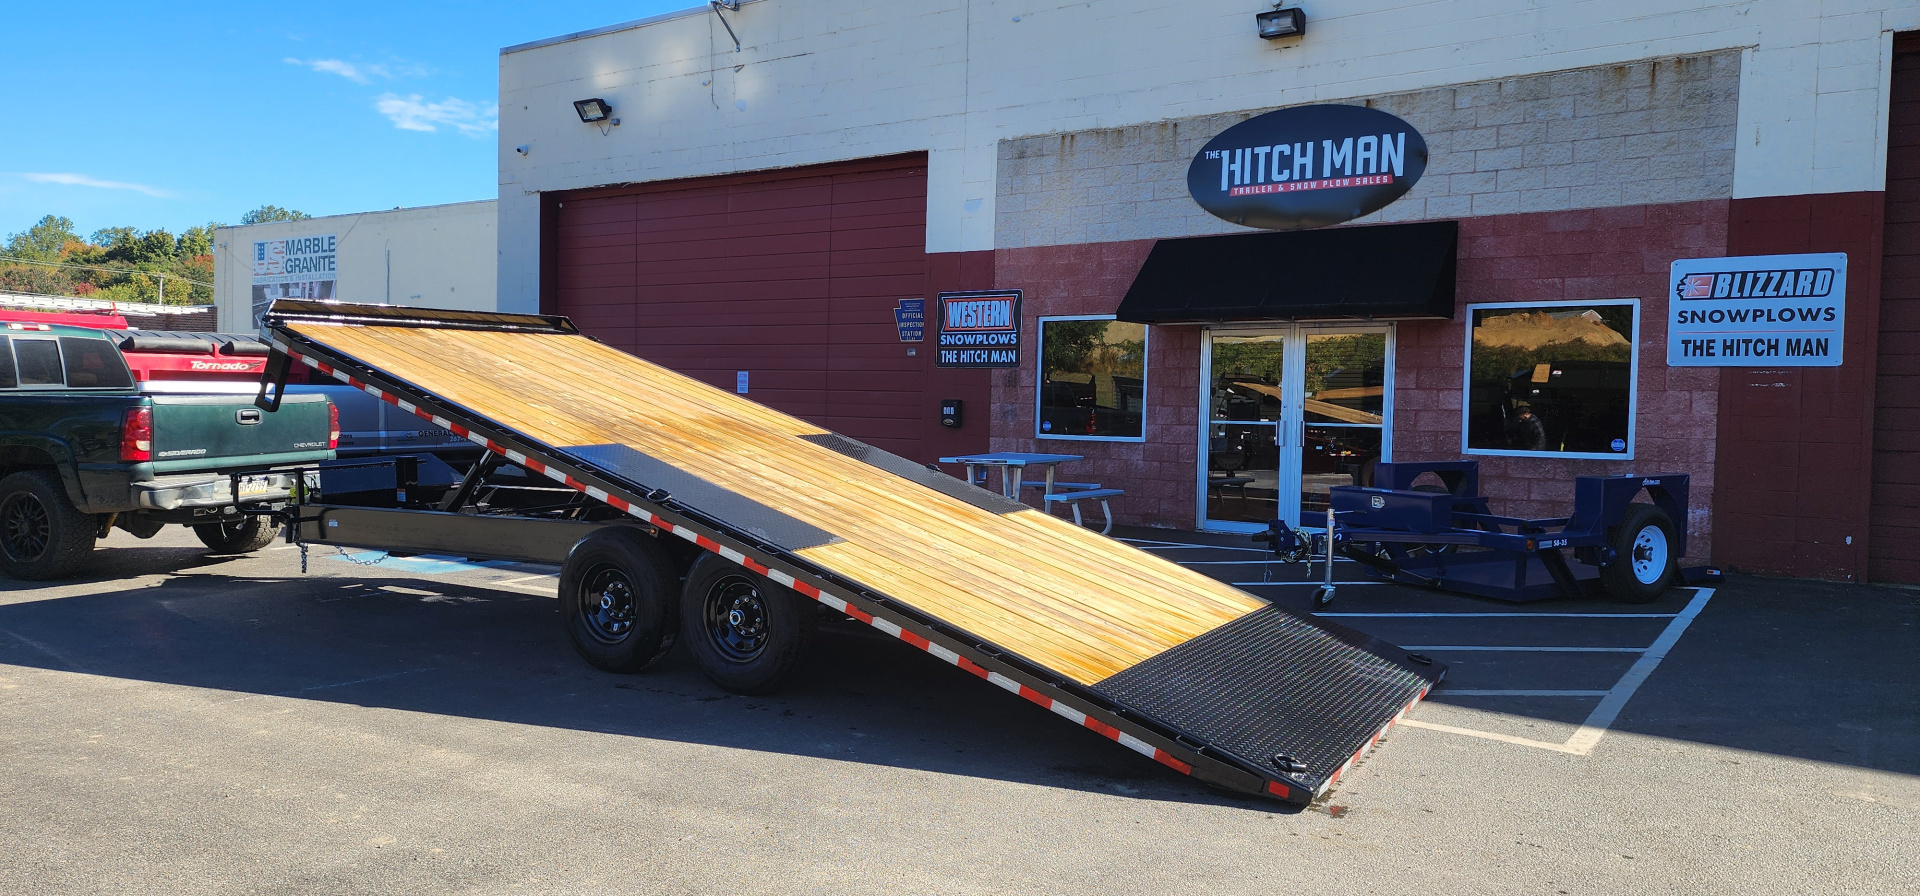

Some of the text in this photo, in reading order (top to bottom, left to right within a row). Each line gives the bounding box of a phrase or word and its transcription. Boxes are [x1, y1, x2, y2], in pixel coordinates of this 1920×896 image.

[1205, 132, 1405, 192] THE HITCH MAN
[1233, 186, 1273, 195] TRAILER
[1290, 181, 1318, 190] SNOW
[1322, 178, 1350, 188] PLOW
[1355, 175, 1388, 185] SALES
[253, 236, 336, 277] US MARBLE
[285, 254, 336, 274] GRANITE
[253, 275, 288, 284] FABRICATION
[295, 273, 336, 281] INSTALLATION
[1713, 269, 1833, 299] BLIZZARD
[948, 300, 1010, 328] WESTERN
[1677, 307, 1836, 325] SNOWPLOWS
[940, 334, 1017, 345] SNOWPLOWS
[1681, 338, 1829, 357] THE HITCH MAN
[190, 360, 249, 370] Tornado
[941, 350, 1016, 363] THE HITCH MAN
